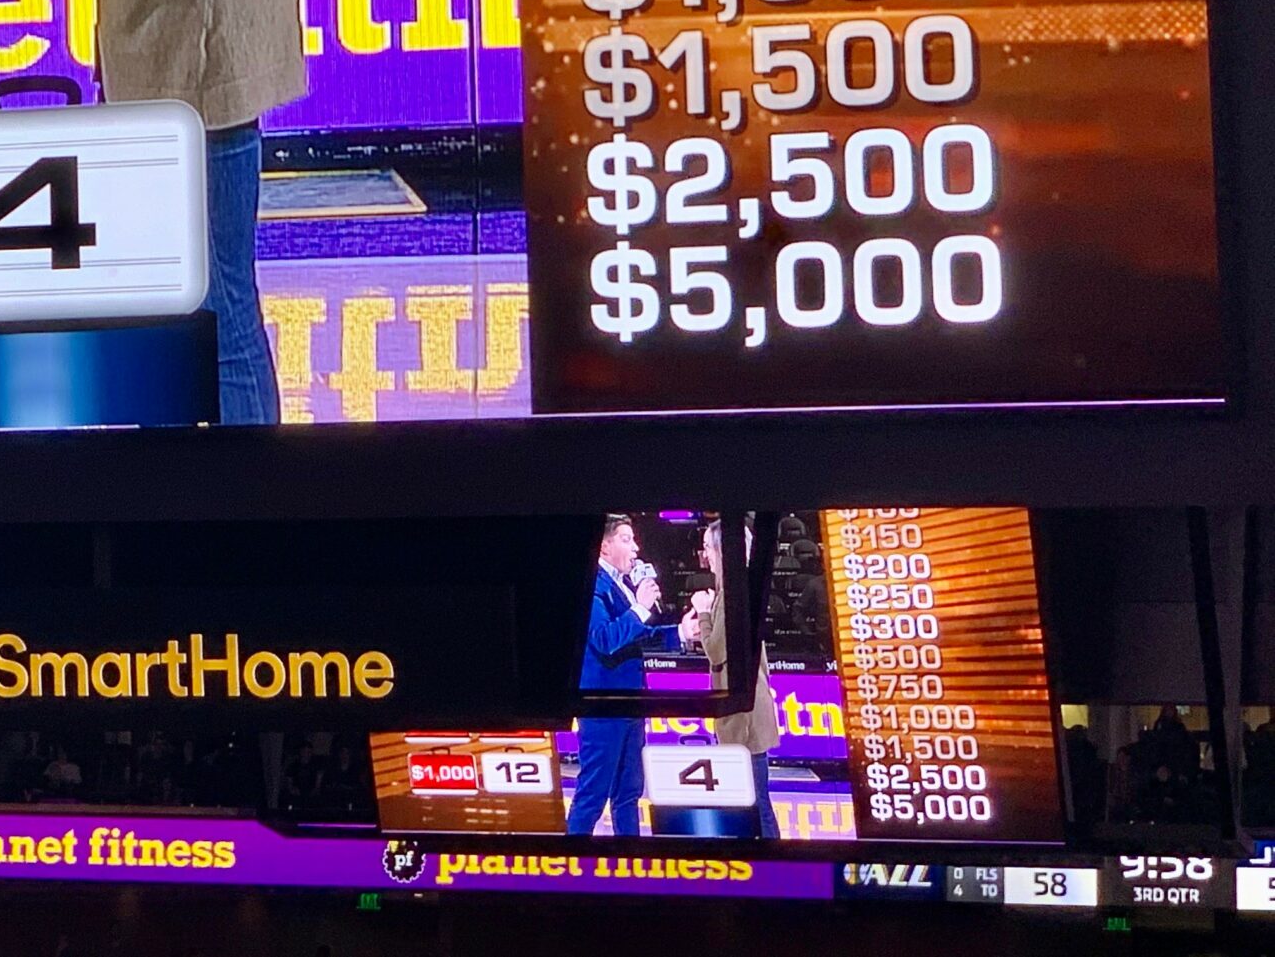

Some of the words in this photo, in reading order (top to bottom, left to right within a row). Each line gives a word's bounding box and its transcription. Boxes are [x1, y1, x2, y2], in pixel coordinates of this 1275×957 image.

[582, 13, 976, 129] $1,500
[586, 122, 998, 238] $2,500
[588, 234, 1005, 348] $5,000
[840, 524, 923, 552] $150
[843, 552, 931, 581] $200
[846, 582, 934, 611] $250
[849, 612, 939, 642] $300
[853, 643, 942, 672] $500
[856, 673, 944, 701] $750
[860, 703, 975, 734] $1,000
[863, 733, 978, 763] $1,500
[411, 764, 475, 782] $1,000
[495, 762, 541, 783] 12
[678, 758, 719, 792] 4
[866, 763, 987, 794] $2,500
[870, 793, 991, 823] $5,000
[89, 828, 235, 870] fitness
[976, 868, 998, 881] FLS
[1034, 872, 1067, 896] 58
[954, 884, 963, 896] 4
[981, 884, 998, 897] TO
[1133, 887, 1164, 902] 3RD
[1167, 887, 1200, 904] QTR
